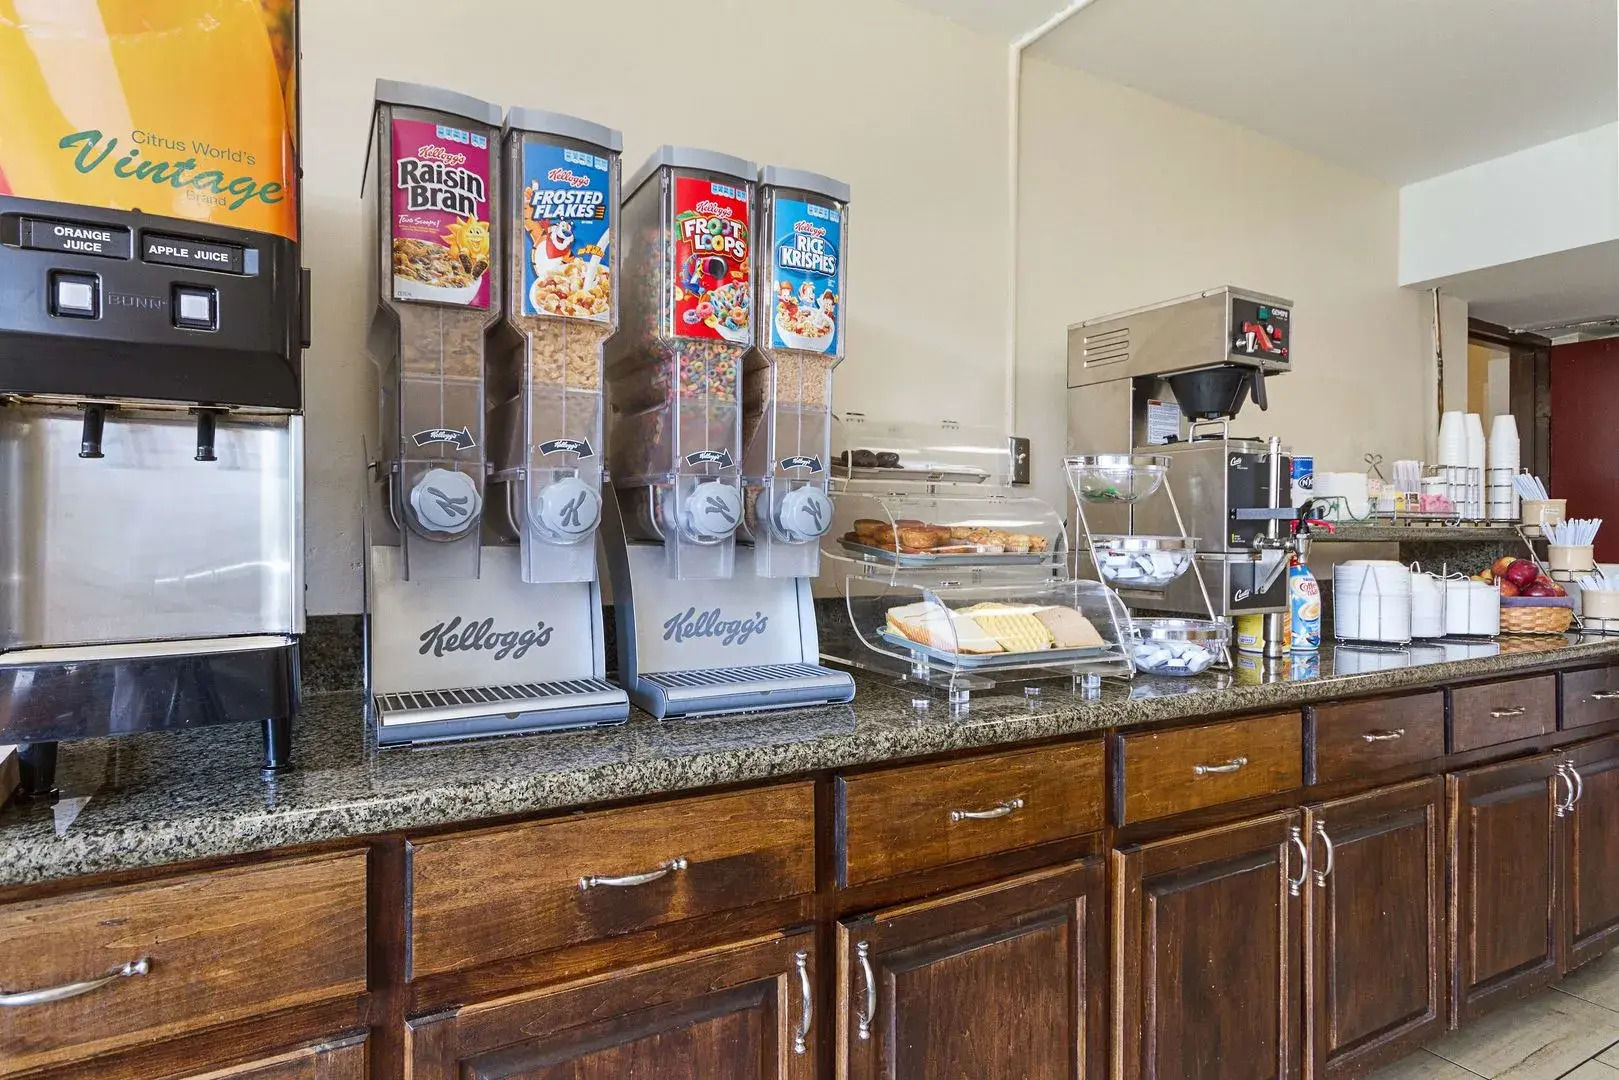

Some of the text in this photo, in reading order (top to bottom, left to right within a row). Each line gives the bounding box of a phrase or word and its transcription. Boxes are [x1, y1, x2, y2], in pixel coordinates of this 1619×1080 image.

[131, 129, 256, 166] Citrus World's
[418, 144, 466, 166] Kellogg's
[59, 129, 284, 210] Vintage
[548, 168, 590, 188] Kellogg's
[398, 158, 486, 202] Raisin
[185, 189, 227, 207] Brand
[408, 183, 478, 220] Bran
[532, 189, 603, 206] FROSTED
[533, 205, 596, 220] FLAKES
[696, 200, 732, 218] Kellogg's
[54, 226, 111, 242] ORANGE
[684, 217, 742, 239] FROOT
[794, 220, 826, 237] Kellogg's
[63, 239, 102, 253] JUICE
[148, 244, 229, 262] APPLE JUICE
[695, 234, 745, 258] LOOPS
[796, 234, 825, 255] RICE
[781, 248, 836, 274] KRISPIES
[430, 430, 460, 441] Kellogg's
[554, 441, 581, 451] Kellogg's
[699, 452, 722, 462] Kellogg's
[663, 606, 769, 646] Kellogg's
[419, 616, 554, 661] Kellogg's
